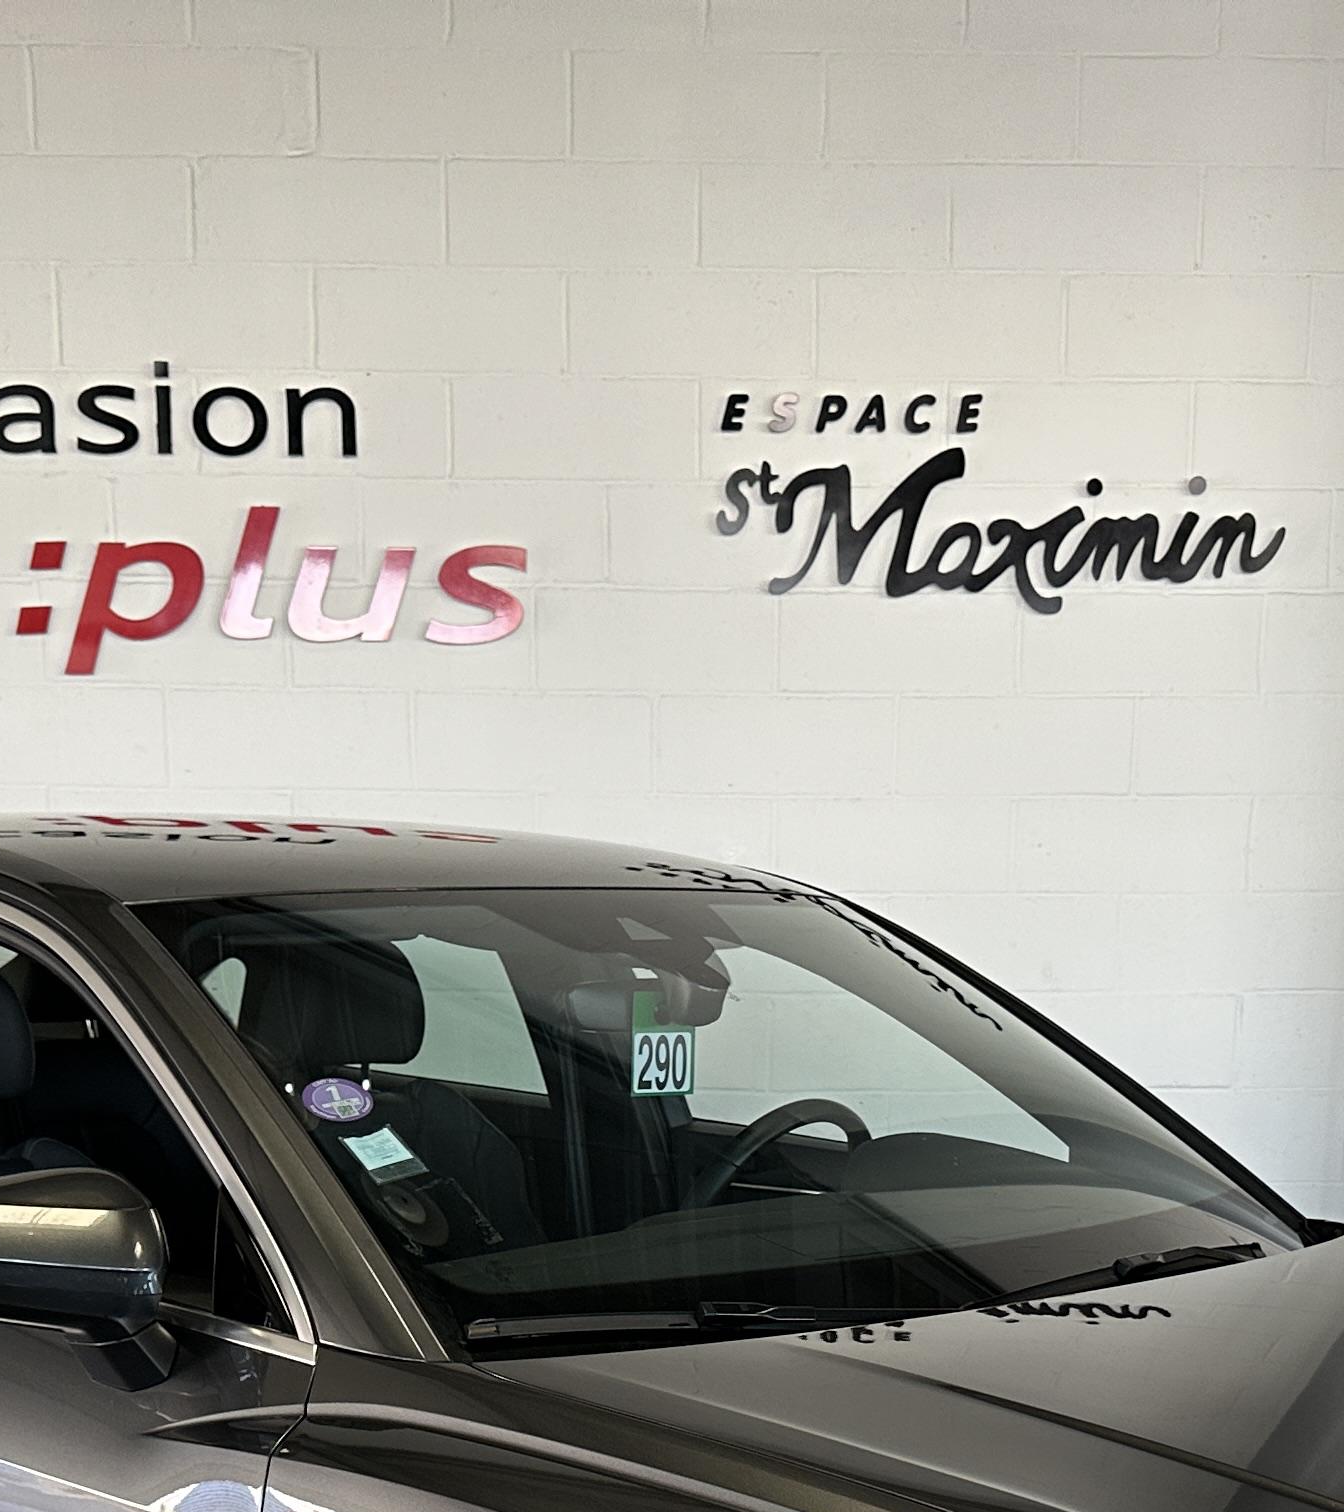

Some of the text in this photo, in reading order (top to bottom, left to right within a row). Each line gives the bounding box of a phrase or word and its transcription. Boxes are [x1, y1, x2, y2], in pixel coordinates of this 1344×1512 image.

[720, 393, 983, 434] ESPACE
[768, 447, 1286, 615] Maximin
[637, 1033, 688, 1091] 290
